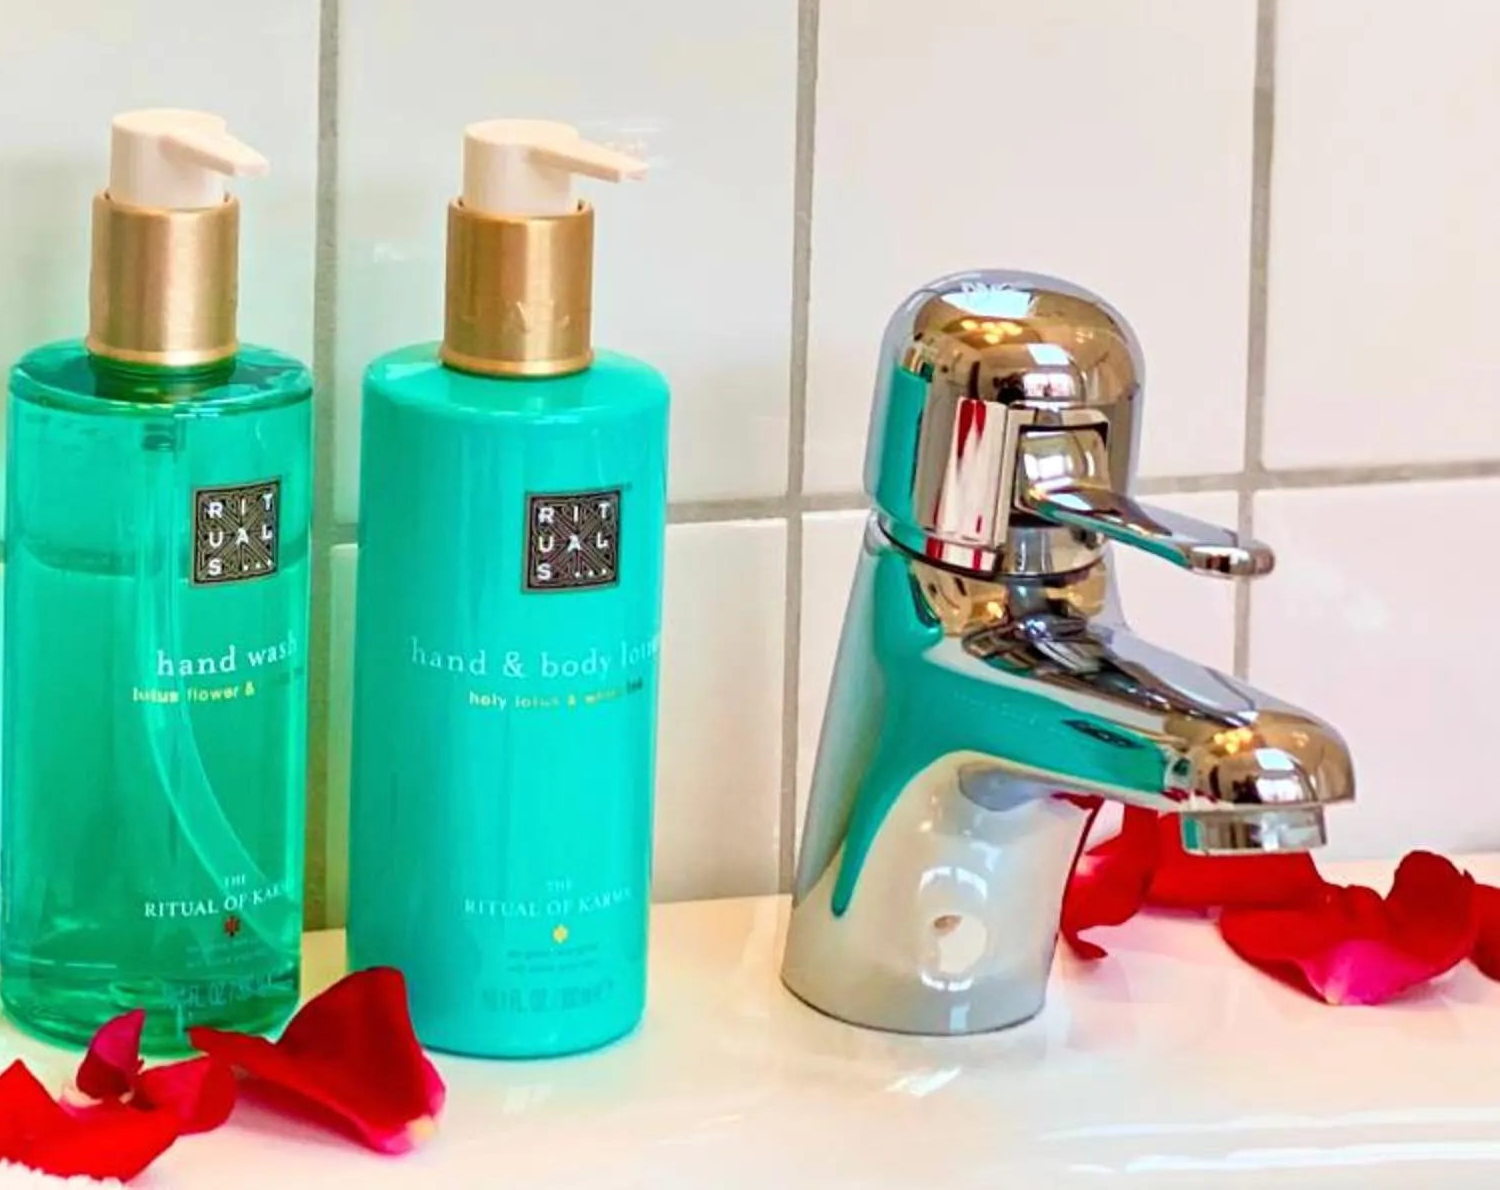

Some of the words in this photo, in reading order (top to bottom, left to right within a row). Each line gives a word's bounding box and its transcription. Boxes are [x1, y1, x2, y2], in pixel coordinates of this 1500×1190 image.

[157, 645, 236, 677] hand
[247, 630, 298, 667] wash
[410, 635, 487, 676] hand
[502, 651, 526, 679] &
[541, 647, 611, 679] body
[469, 691, 507, 710] holy
[144, 900, 218, 917] RITUAL
[223, 893, 247, 911] OF
[464, 899, 538, 917] RITUAL
